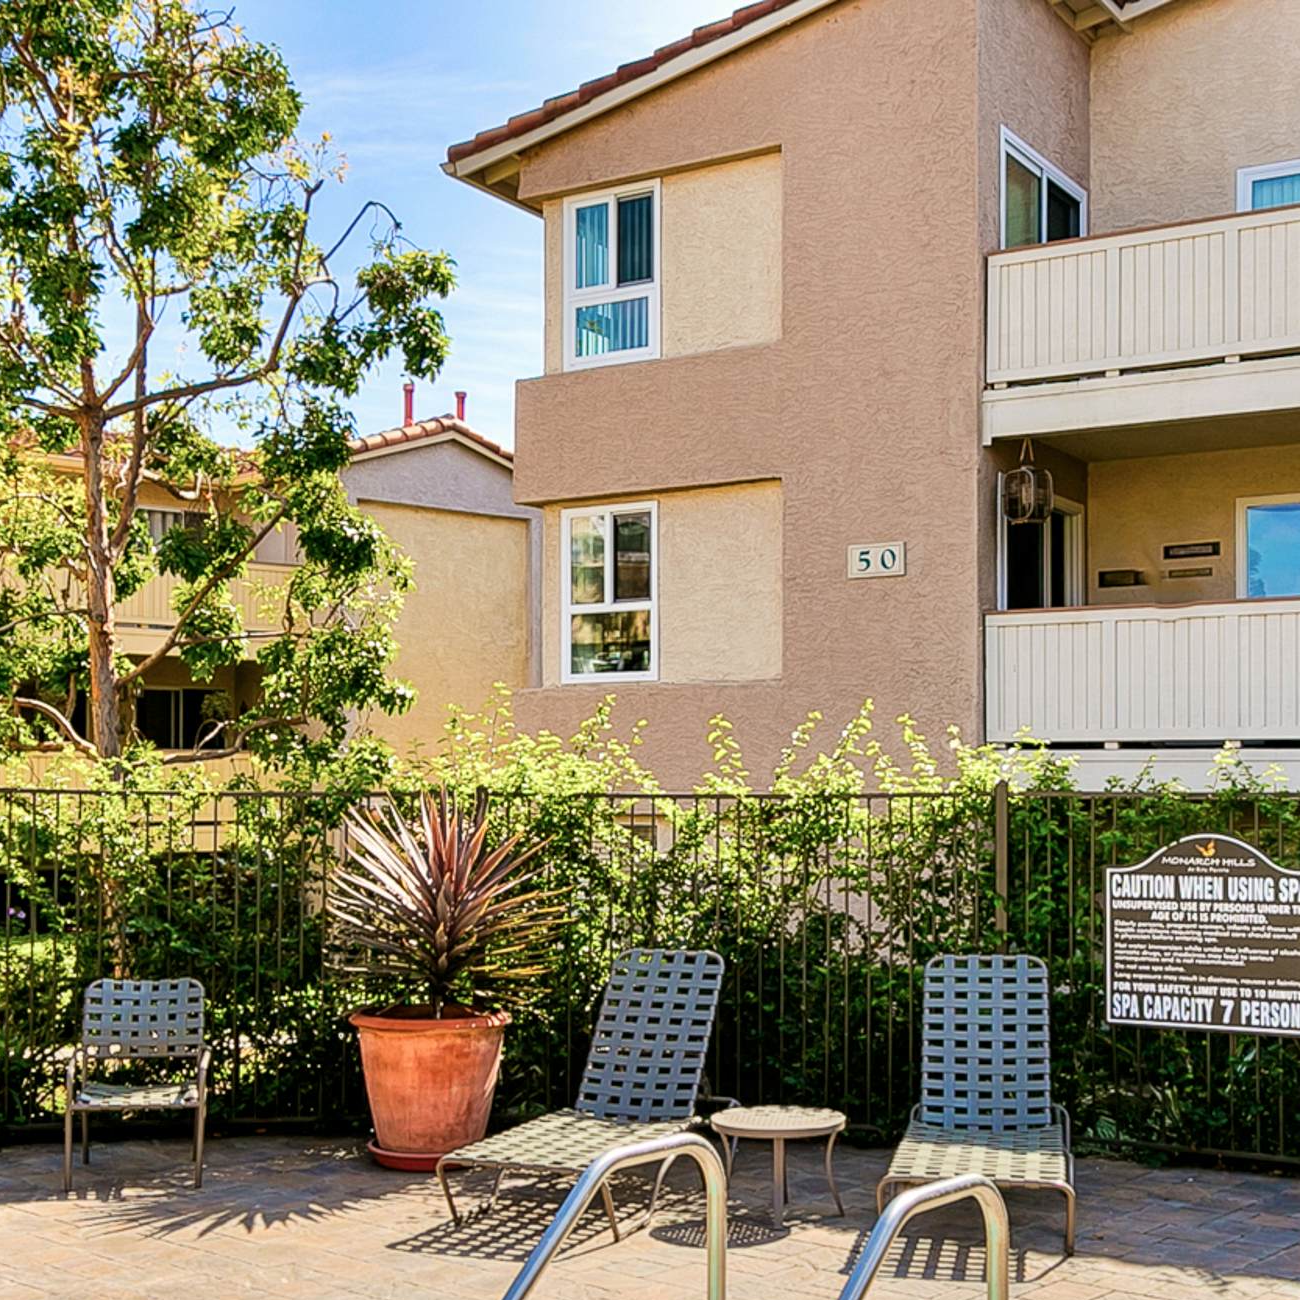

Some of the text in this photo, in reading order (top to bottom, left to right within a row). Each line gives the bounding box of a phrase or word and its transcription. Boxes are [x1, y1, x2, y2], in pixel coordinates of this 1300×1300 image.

[1161, 857, 1256, 867] MONARCH HILLS
[1112, 874, 1175, 898] CAUTION
[1178, 875, 1224, 900] WHEN
[1227, 876, 1275, 902] USING
[1112, 899, 1178, 910] UNSUPERVISED
[1180, 901, 1197, 911] USE
[1199, 902, 1211, 912] BY
[1213, 902, 1255, 913] PERSONS
[1257, 903, 1291, 915] UNDER
[1150, 911, 1268, 924] AGE OF 14 IS PROHIBITED.
[1113, 981, 1131, 991] FOR
[1132, 982, 1156, 992] YOUR
[1157, 984, 1191, 995] SAFETY,
[1193, 985, 1218, 996] LIMIT
[1219, 987, 1238, 998] USE
[1239, 988, 1252, 998] TO
[1254, 989, 1266, 999] 10
[1113, 992, 1139, 1018] SPA
[1143, 994, 1214, 1023] CAPACITY
[1220, 999, 1235, 1024] 7
